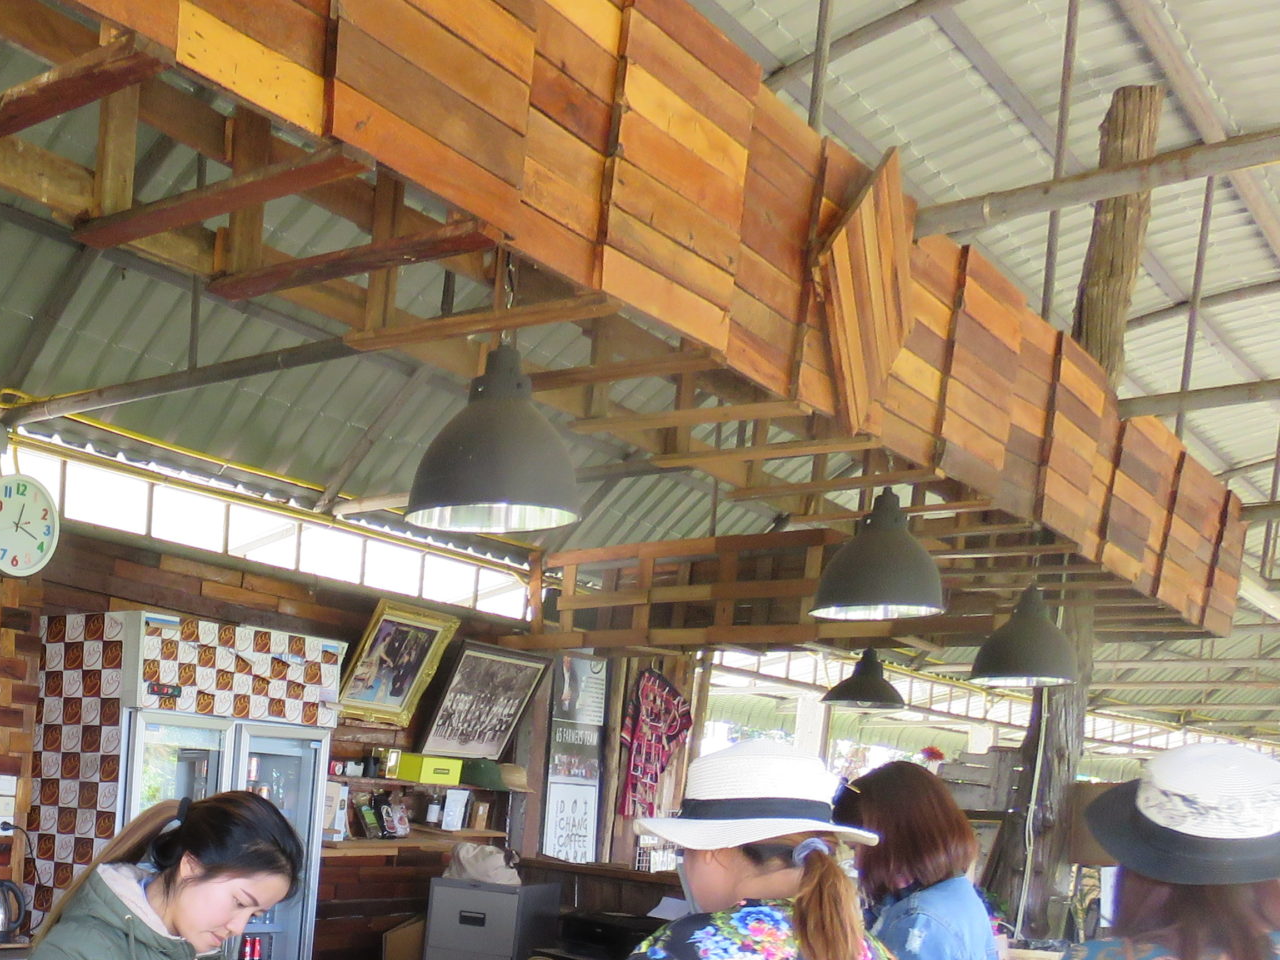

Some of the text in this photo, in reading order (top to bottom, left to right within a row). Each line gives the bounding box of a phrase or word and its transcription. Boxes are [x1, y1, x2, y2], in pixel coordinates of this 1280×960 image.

[4, 486, 12, 498] 11
[16, 483, 27, 496] 12
[41, 509, 48, 520] 2
[43, 525, 51, 536] 3
[37, 541, 44, 553] 4
[0, 548, 8, 560] 7
[11, 555, 18, 567] 6
